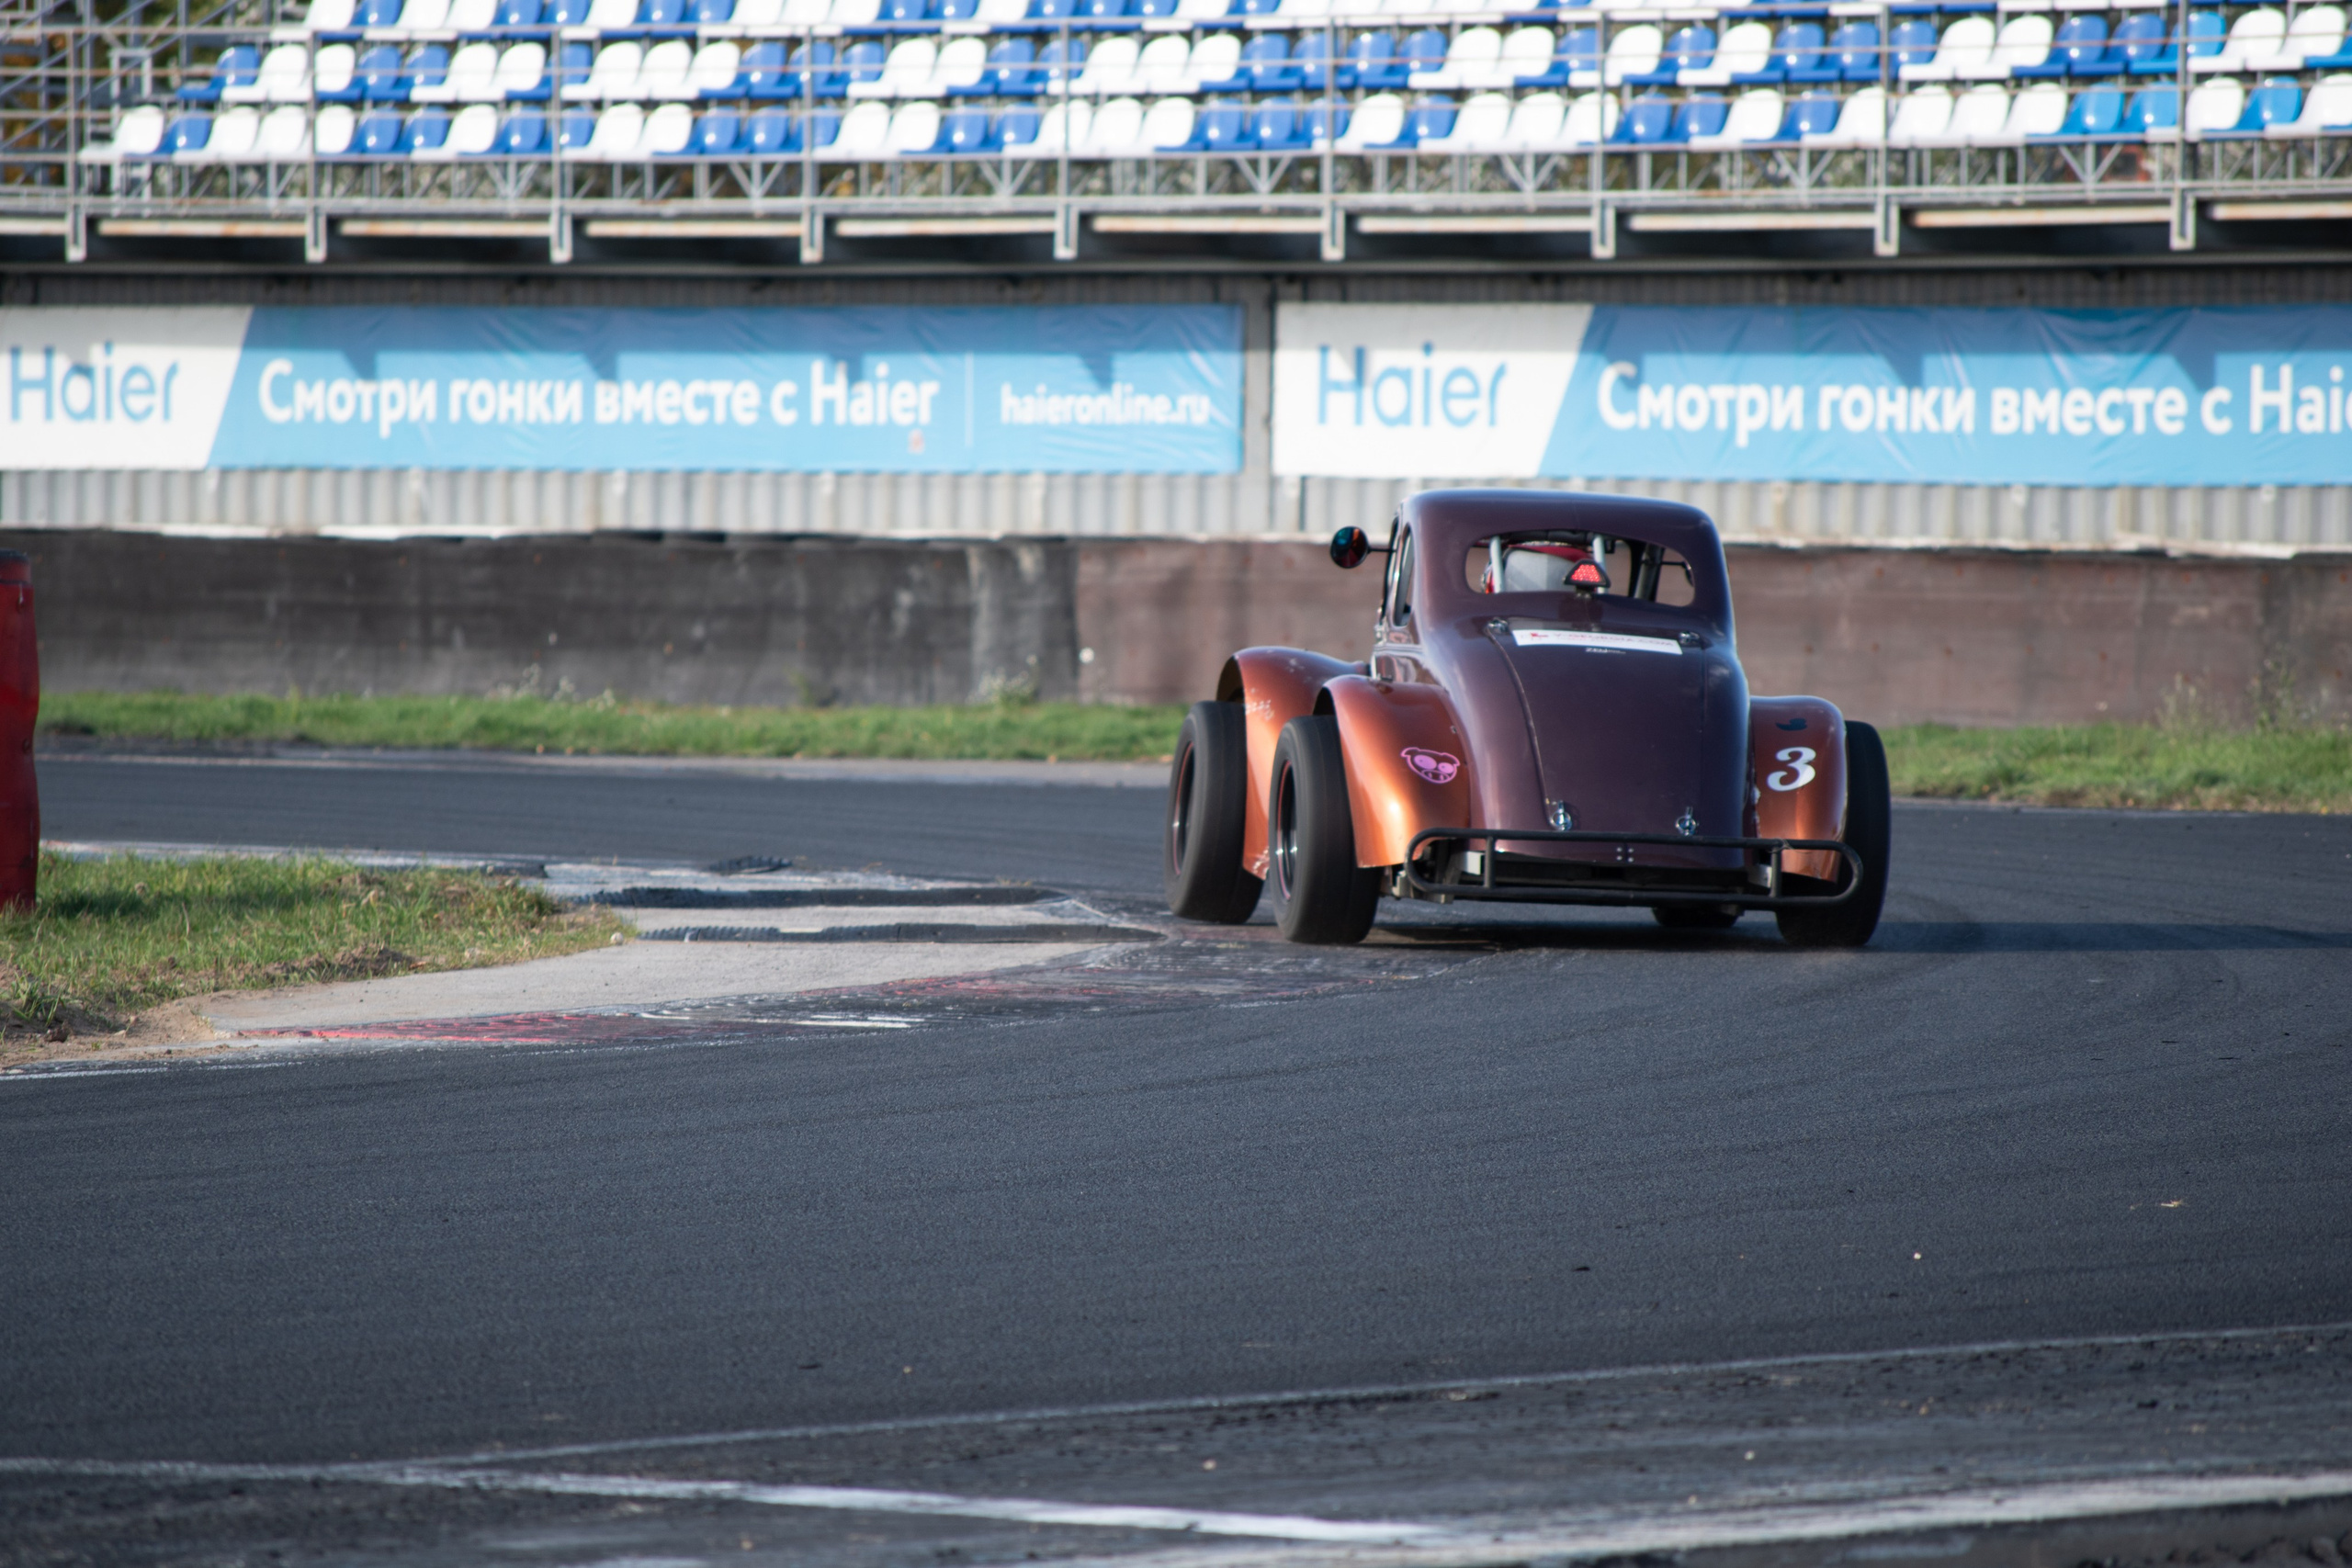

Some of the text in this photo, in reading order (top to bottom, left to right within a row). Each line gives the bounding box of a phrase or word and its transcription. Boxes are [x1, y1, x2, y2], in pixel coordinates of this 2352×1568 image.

[9, 340, 178, 423] Haier
[258, 357, 437, 439] Смотри
[447, 378, 583, 425] гонки
[594, 378, 762, 426] вместе
[811, 359, 941, 426] Haier
[1000, 382, 1211, 425] haieronline.ru
[1317, 340, 1508, 428] Haier
[1597, 361, 1804, 448] Смотри
[1817, 384, 1975, 434] гонки
[1990, 386, 2188, 435] вместе
[2249, 363, 2352, 435] Hai
[1767, 747, 1816, 792] 3
